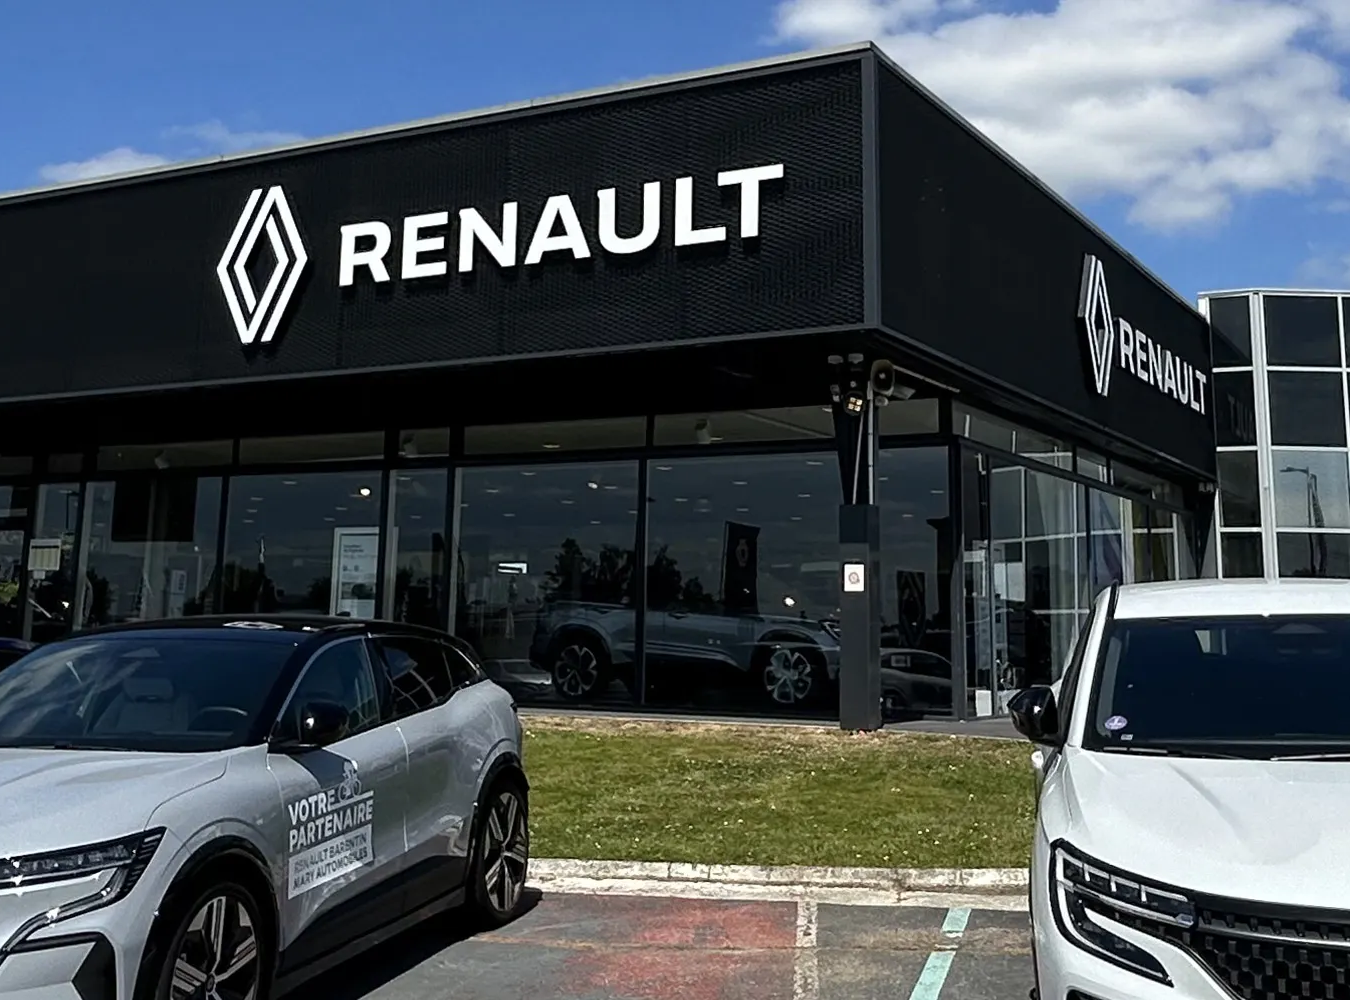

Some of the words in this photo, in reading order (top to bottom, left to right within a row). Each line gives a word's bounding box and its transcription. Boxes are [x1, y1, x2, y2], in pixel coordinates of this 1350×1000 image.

[338, 163, 784, 286] RENAULT
[1118, 317, 1207, 415] RENAULT
[288, 789, 336, 825] VOTRE
[289, 799, 374, 853] PARTENAIRE
